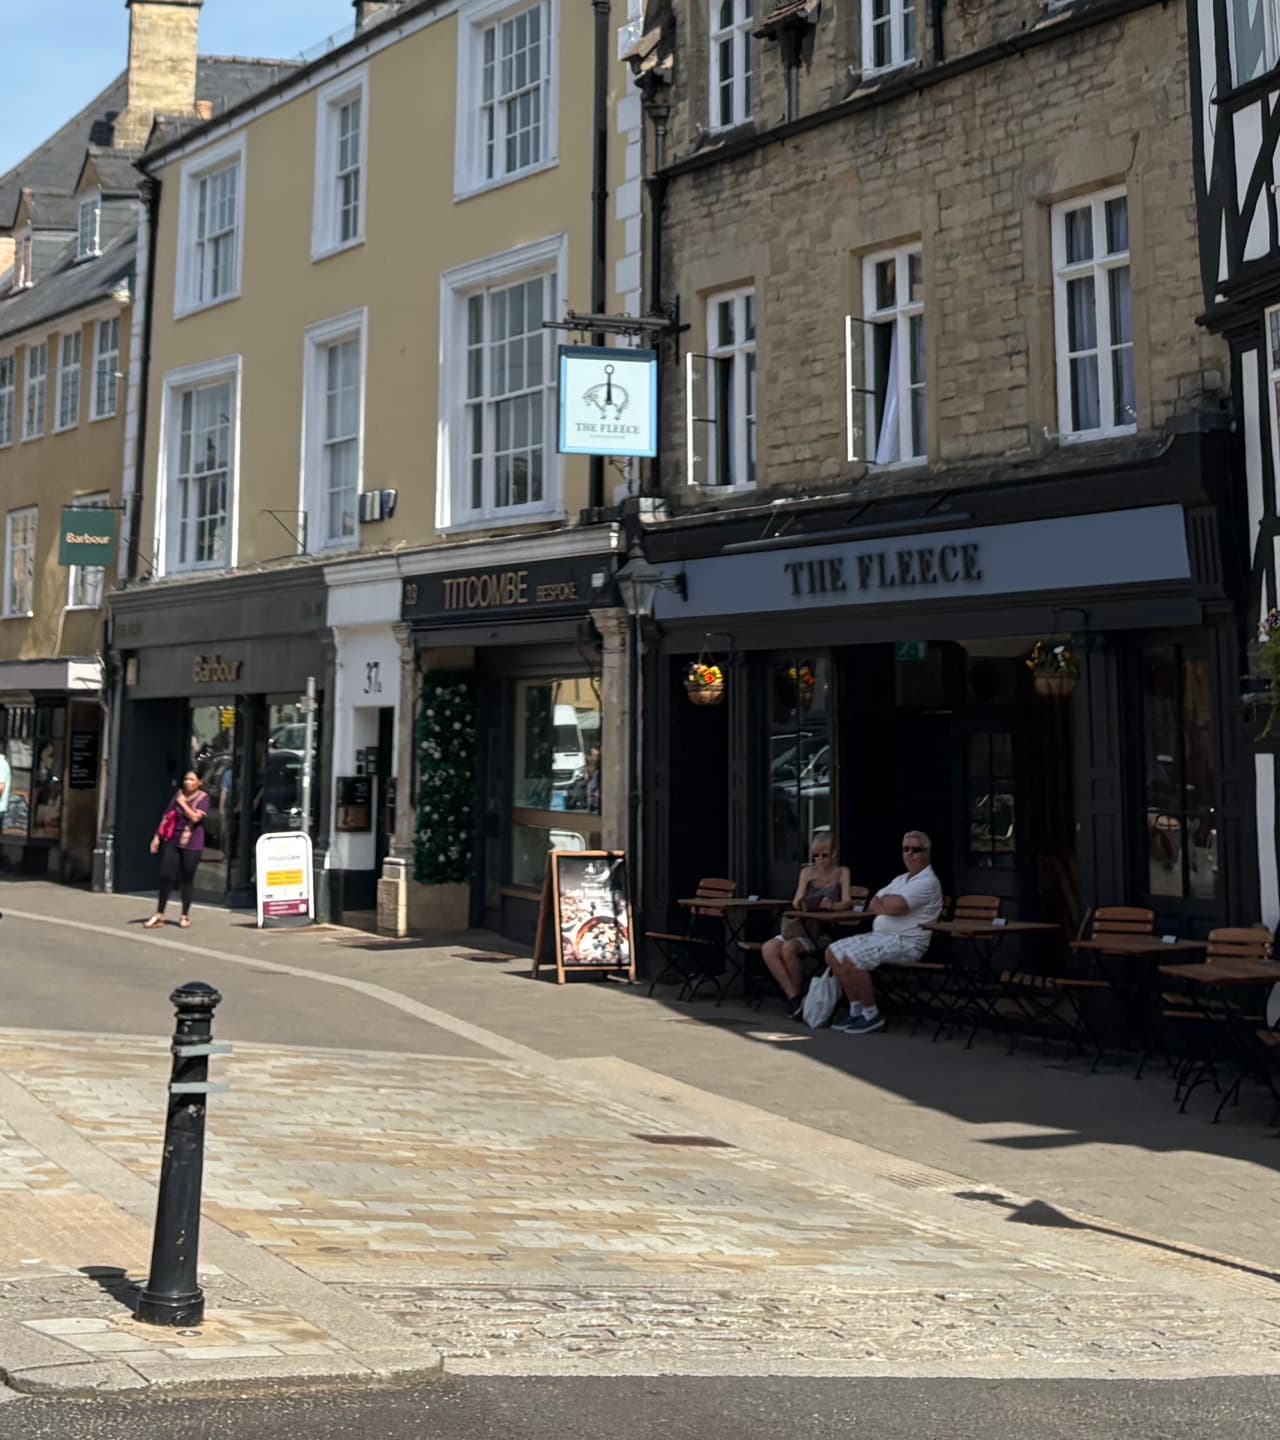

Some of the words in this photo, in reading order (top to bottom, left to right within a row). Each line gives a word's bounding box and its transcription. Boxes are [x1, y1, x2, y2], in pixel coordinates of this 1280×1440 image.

[576, 423, 598, 432] THE
[600, 424, 640, 434] FLEECE
[66, 531, 111, 544] Barbour
[784, 558, 847, 596] THE
[856, 544, 984, 590] FLEECE
[443, 571, 529, 609] TITCOMBE
[536, 582, 577, 602] BESPOKE
[193, 656, 241, 683] Barbour
